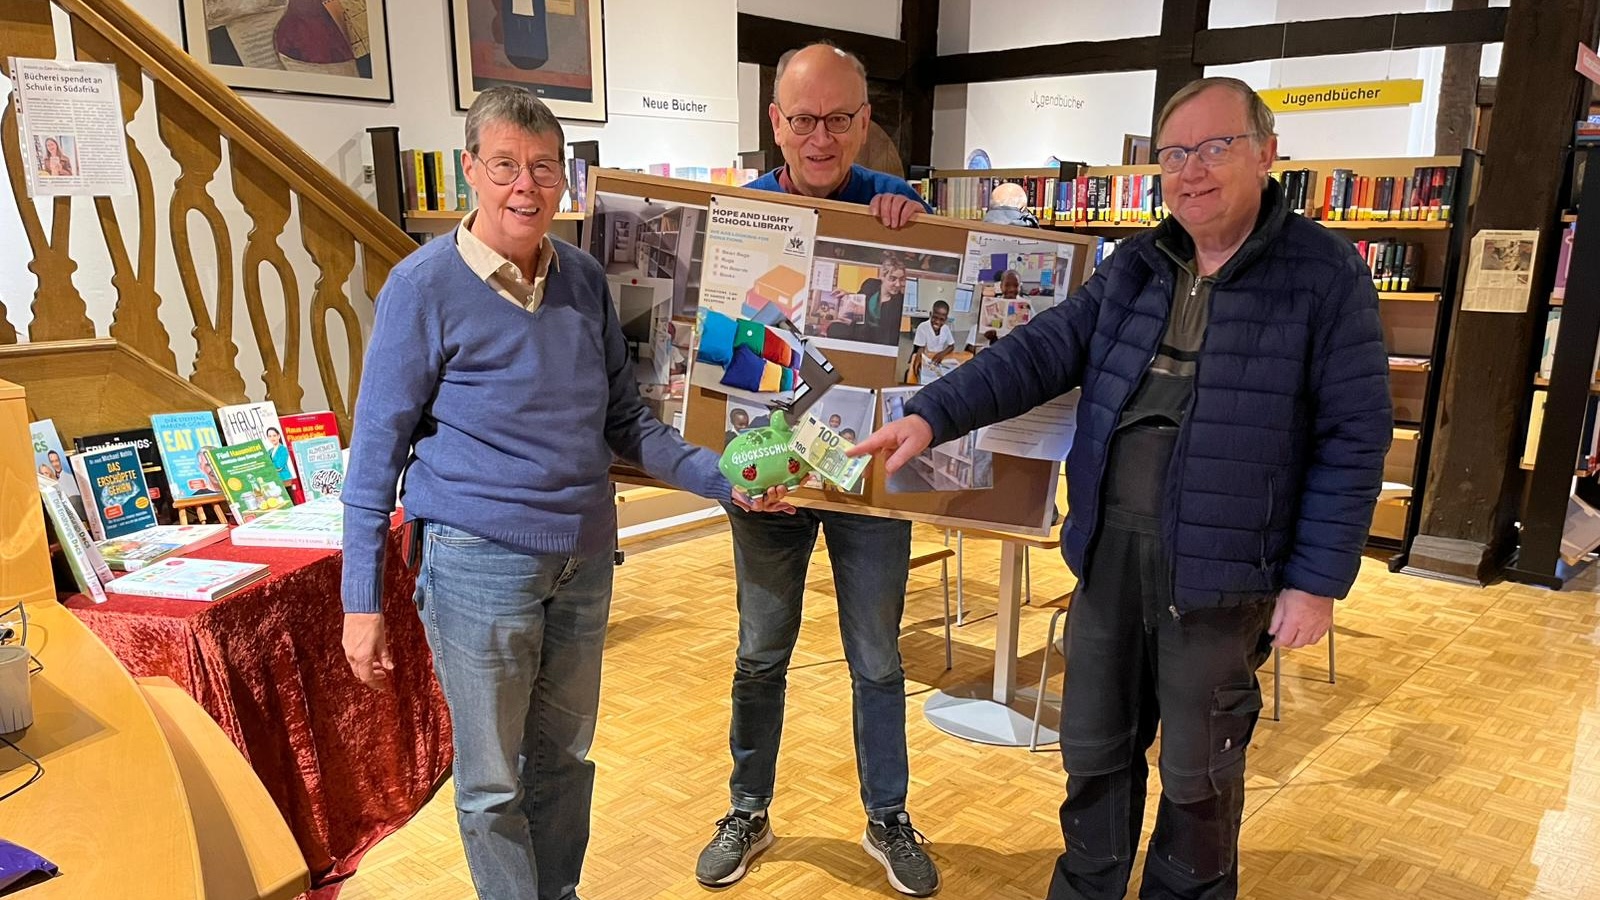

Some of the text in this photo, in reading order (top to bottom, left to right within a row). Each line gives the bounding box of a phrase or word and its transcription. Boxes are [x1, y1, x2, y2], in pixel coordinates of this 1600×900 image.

[24, 72, 60, 82] Bücherei
[61, 75, 92, 85] spendet
[26, 83, 52, 92] Schule
[63, 85, 100, 94] Südafrika
[643, 97, 707, 113] Neue Bücher
[1031, 90, 1085, 109] Jugendbücher
[1282, 88, 1381, 106] Jugendbücher
[712, 208, 789, 223] HOPE AND LIGHT
[712, 216, 793, 232] SCHOOL LIBRARY
[227, 407, 265, 435] HAUT
[162, 427, 219, 452] EAT IT!
[818, 426, 840, 448] 100
[731, 443, 794, 465] GLÜCKSSCHW
[794, 441, 807, 455] 100
[106, 462, 121, 473] DAS
[96, 469, 137, 488] ERSCHÖPFTE
[108, 482, 132, 496] GEHIRN
